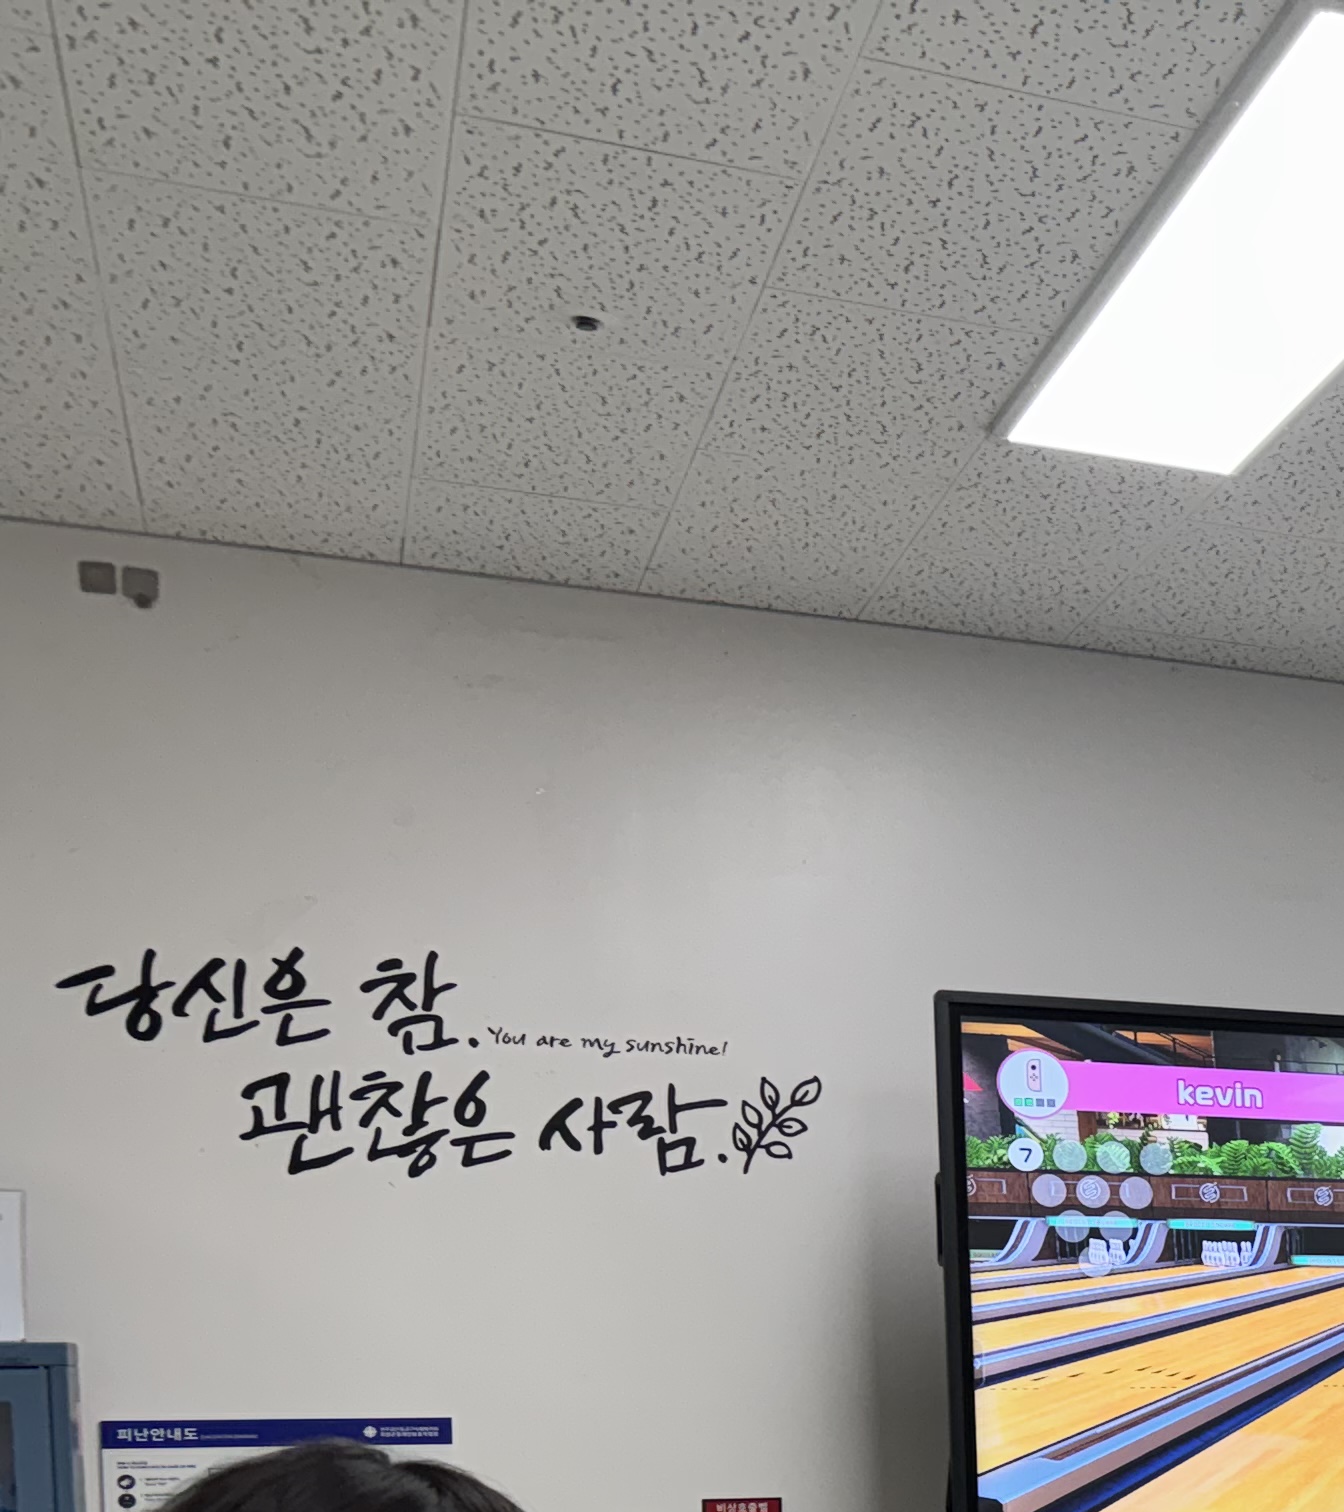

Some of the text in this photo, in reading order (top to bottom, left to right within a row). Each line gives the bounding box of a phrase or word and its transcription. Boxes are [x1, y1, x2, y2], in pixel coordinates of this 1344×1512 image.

[55, 947, 332, 1047] 당신은
[487, 1027, 729, 1058] You are my sunshine!
[1177, 1078, 1264, 1110] kevin
[239, 1069, 516, 1178] 괜찮은
[1018, 1147, 1033, 1163] 7
[116, 1427, 199, 1442] 피난안내도
